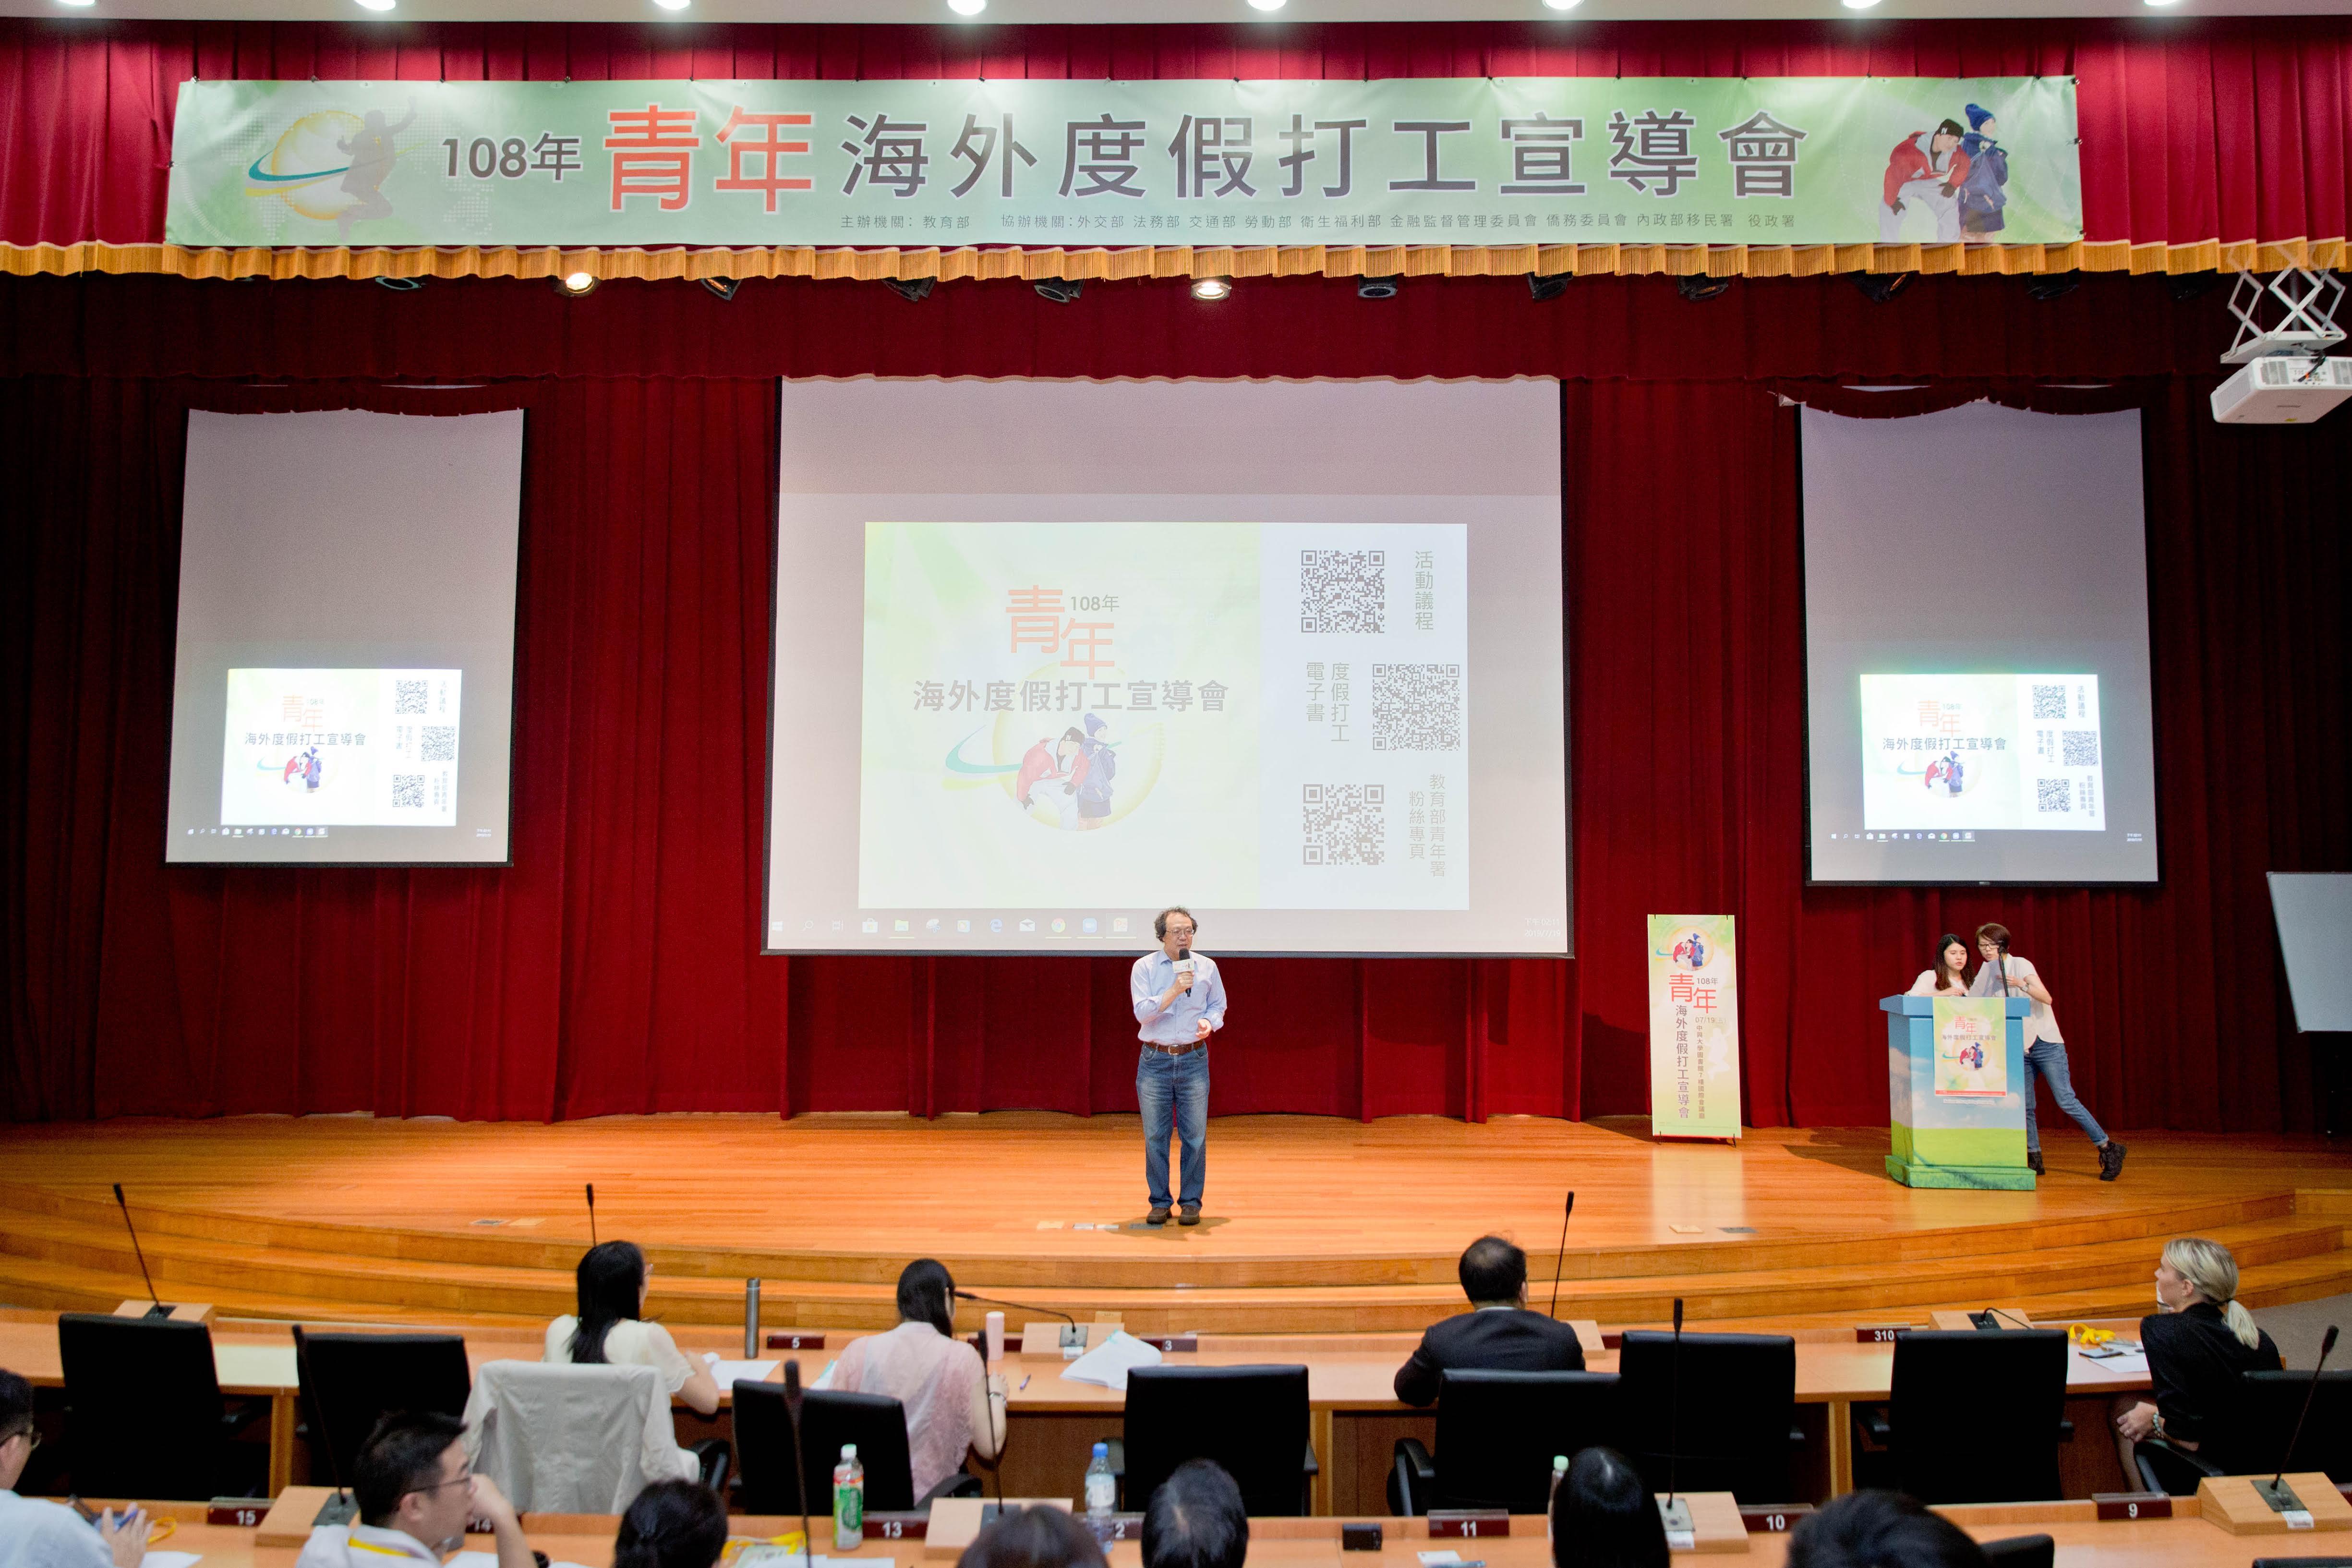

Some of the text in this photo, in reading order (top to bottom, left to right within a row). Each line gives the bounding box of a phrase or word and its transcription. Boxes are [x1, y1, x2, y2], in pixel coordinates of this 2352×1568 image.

[443, 104, 1806, 212] 108年 青年 海外度假打工宣導會
[923, 215, 969, 229] 教育部
[1133, 215, 1180, 228] 法務部
[1189, 215, 1236, 228] 交通部
[1245, 215, 1292, 228] 勞動部
[1301, 214, 1381, 228] 衛生福利部
[1390, 214, 1537, 228] 金融監督管理委員會
[1546, 214, 1627, 228] 僑務委員會
[1637, 213, 1733, 227] 內政部移民署
[1748, 214, 1794, 228] 役政署
[1415, 550, 1434, 630] 活動議程
[1070, 594, 1120, 612] 108年
[1006, 584, 1115, 680] 青年
[913, 679, 1229, 712] 海外度假打工宣導會
[1306, 662, 1325, 722] 電子書
[1331, 662, 1350, 742] 度假打工
[245, 733, 366, 746] 海外度假打工宣導會
[1883, 737, 2006, 750] 海外度假打工宣導會
[1409, 791, 1425, 860] 粉絲專頁
[1429, 774, 1446, 878] 教育部青年署
[1669, 973, 1717, 1014] 青年
[1954, 1015, 1977, 1034] 青年
[1676, 1005, 1689, 1119] 海外度假打工宣導會
[791, 1337, 800, 1349] 5
[1874, 1329, 1894, 1342] 310
[1165, 1340, 1172, 1351] 3
[237, 1510, 256, 1526] 15
[2128, 1503, 2138, 1519] 9
[882, 1521, 903, 1539] 13
[1460, 1520, 1477, 1537] 11
[1766, 1514, 1785, 1531] 10
